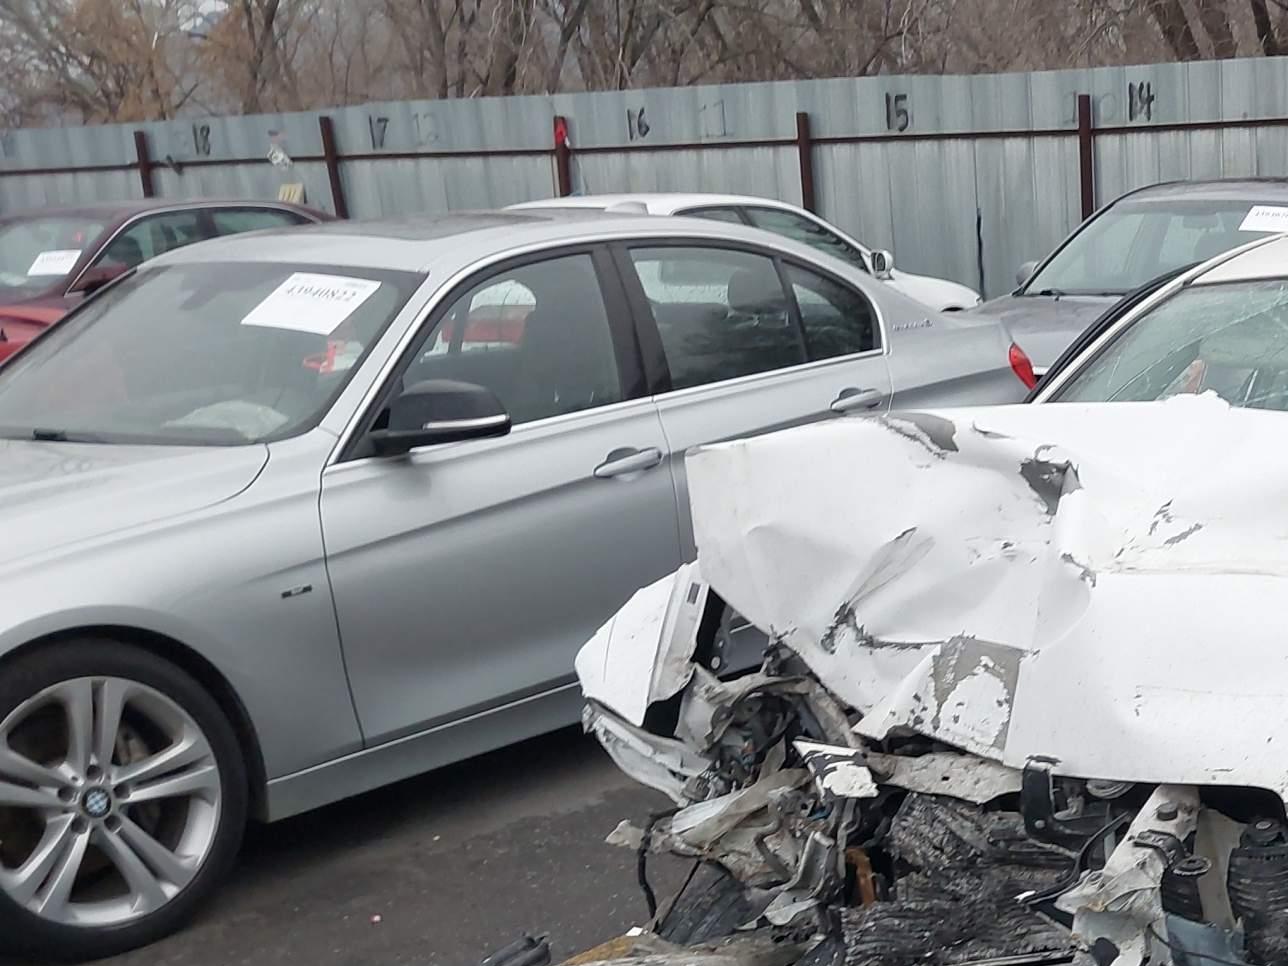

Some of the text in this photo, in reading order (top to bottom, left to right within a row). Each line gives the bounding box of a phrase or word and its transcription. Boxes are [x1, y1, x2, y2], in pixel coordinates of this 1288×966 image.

[885, 92, 909, 132] 15
[1128, 82, 1155, 122] 14
[192, 122, 211, 156] 18
[368, 114, 390, 150] 17
[627, 106, 650, 141] 16
